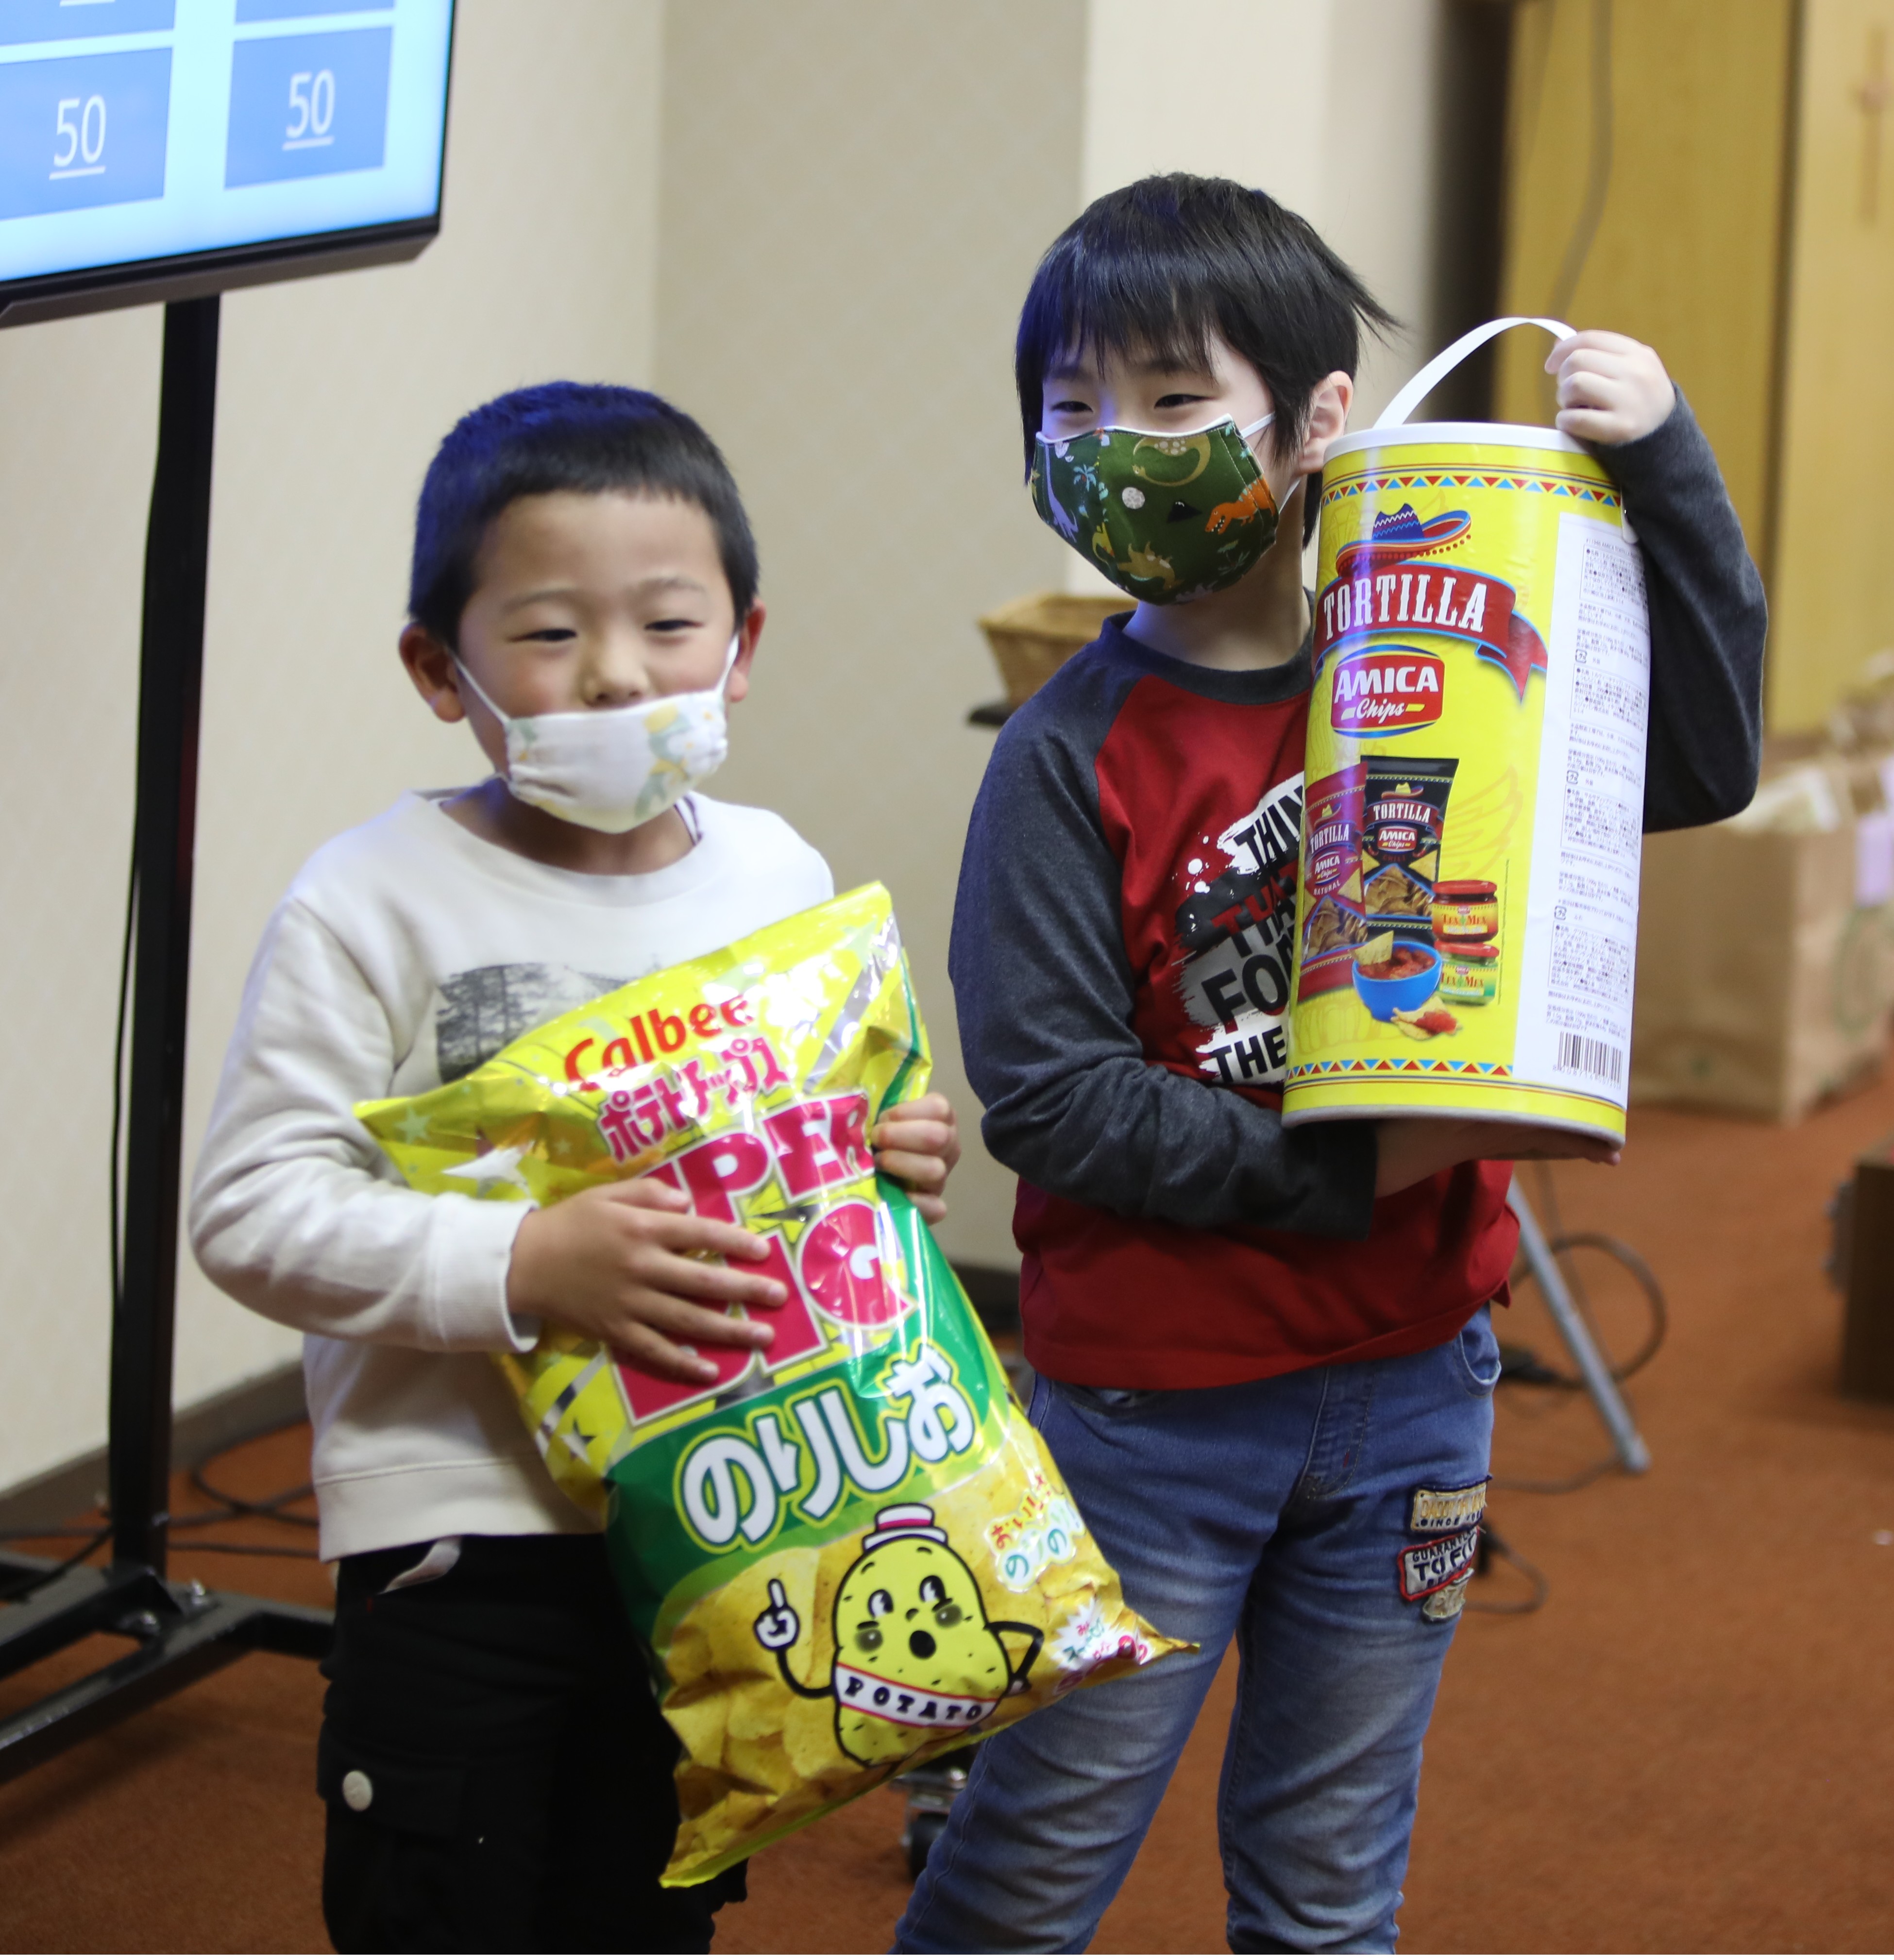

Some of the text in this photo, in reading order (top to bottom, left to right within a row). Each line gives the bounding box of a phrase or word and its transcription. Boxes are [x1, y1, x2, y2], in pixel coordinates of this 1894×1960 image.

[287, 70, 335, 138] 50
[53, 95, 106, 167] 50
[1323, 574, 1488, 641] TORTILLA
[1334, 666, 1439, 704] AMICA
[1356, 698, 1405, 724] Chips
[1373, 803, 1432, 824] TORTILLA
[1310, 824, 1350, 854] TORTILLA
[1379, 830, 1416, 842] AMICA
[1388, 840, 1405, 849] Chips
[1315, 856, 1340, 875] AMICA
[1321, 868, 1333, 879] Chips
[1313, 880, 1341, 896] NATURAL
[1441, 913, 1487, 925] TEX MEX
[1440, 973, 1485, 987] TEX MEX
[564, 995, 754, 1093] Calbee
[1210, 1025, 1287, 1083] THE
[598, 1036, 790, 1163] ポテトチップス
[637, 1091, 874, 1226] PER
[682, 1342, 974, 1544] のりしお
[1413, 1532, 1476, 1581] TO FIT
[844, 1676, 983, 1720] POTATO
